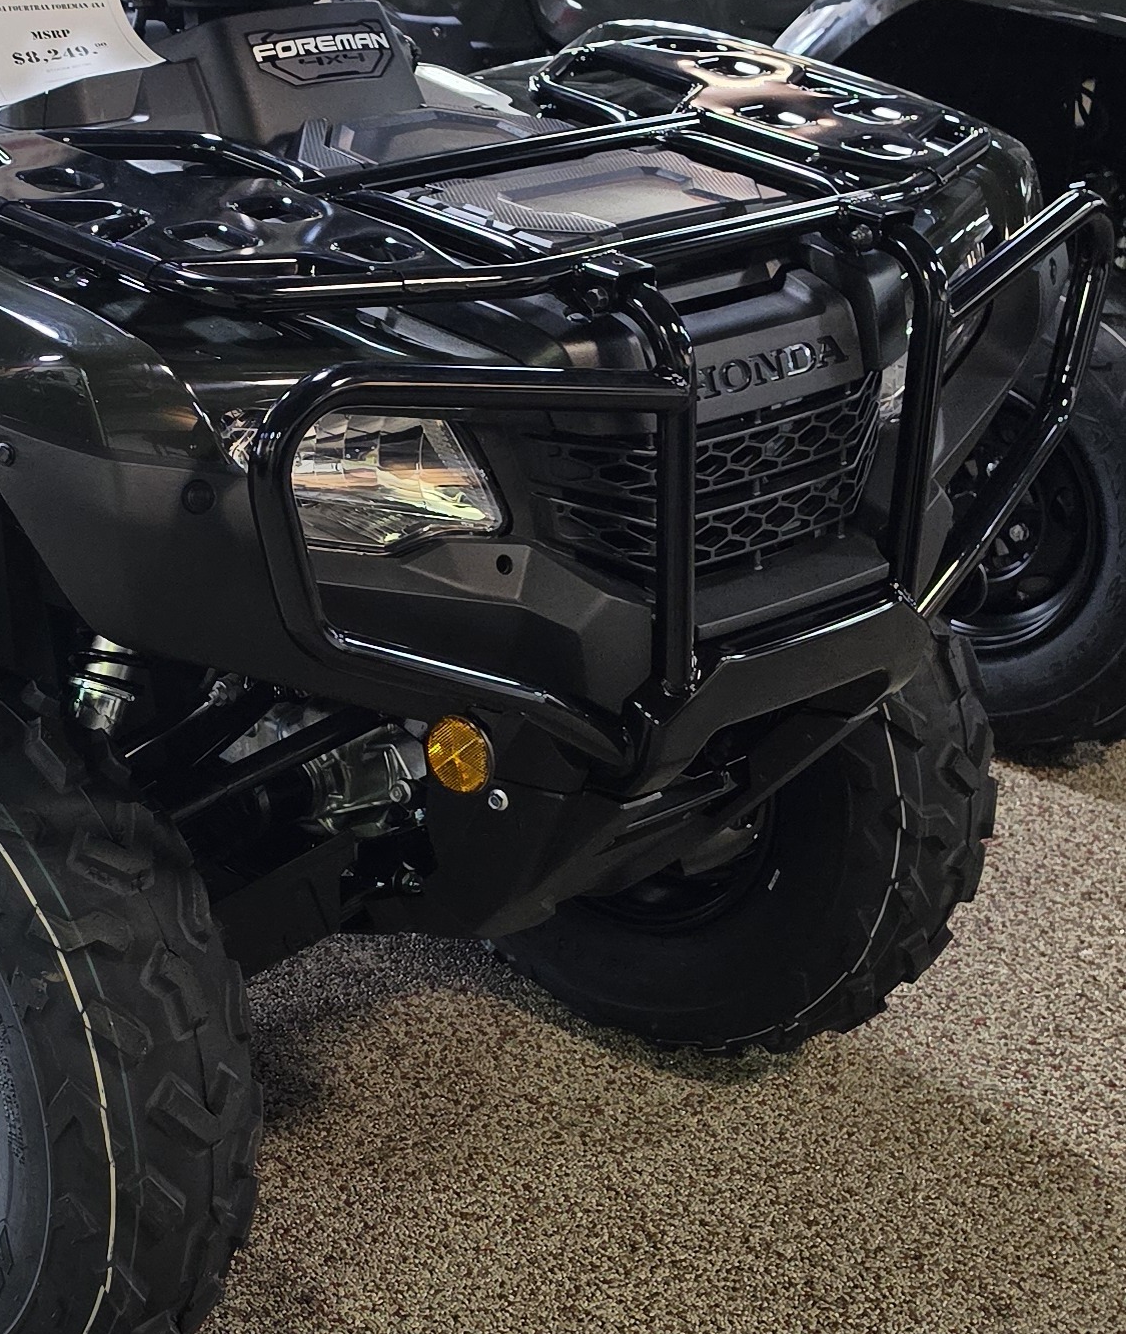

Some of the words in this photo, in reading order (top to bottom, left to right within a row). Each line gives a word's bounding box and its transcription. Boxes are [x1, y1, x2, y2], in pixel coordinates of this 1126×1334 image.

[8, 3, 51, 12] FOURTRAX
[51, 2, 89, 11] FOREMAN
[30, 28, 71, 40] MSRP
[252, 32, 390, 63] FOREMAN
